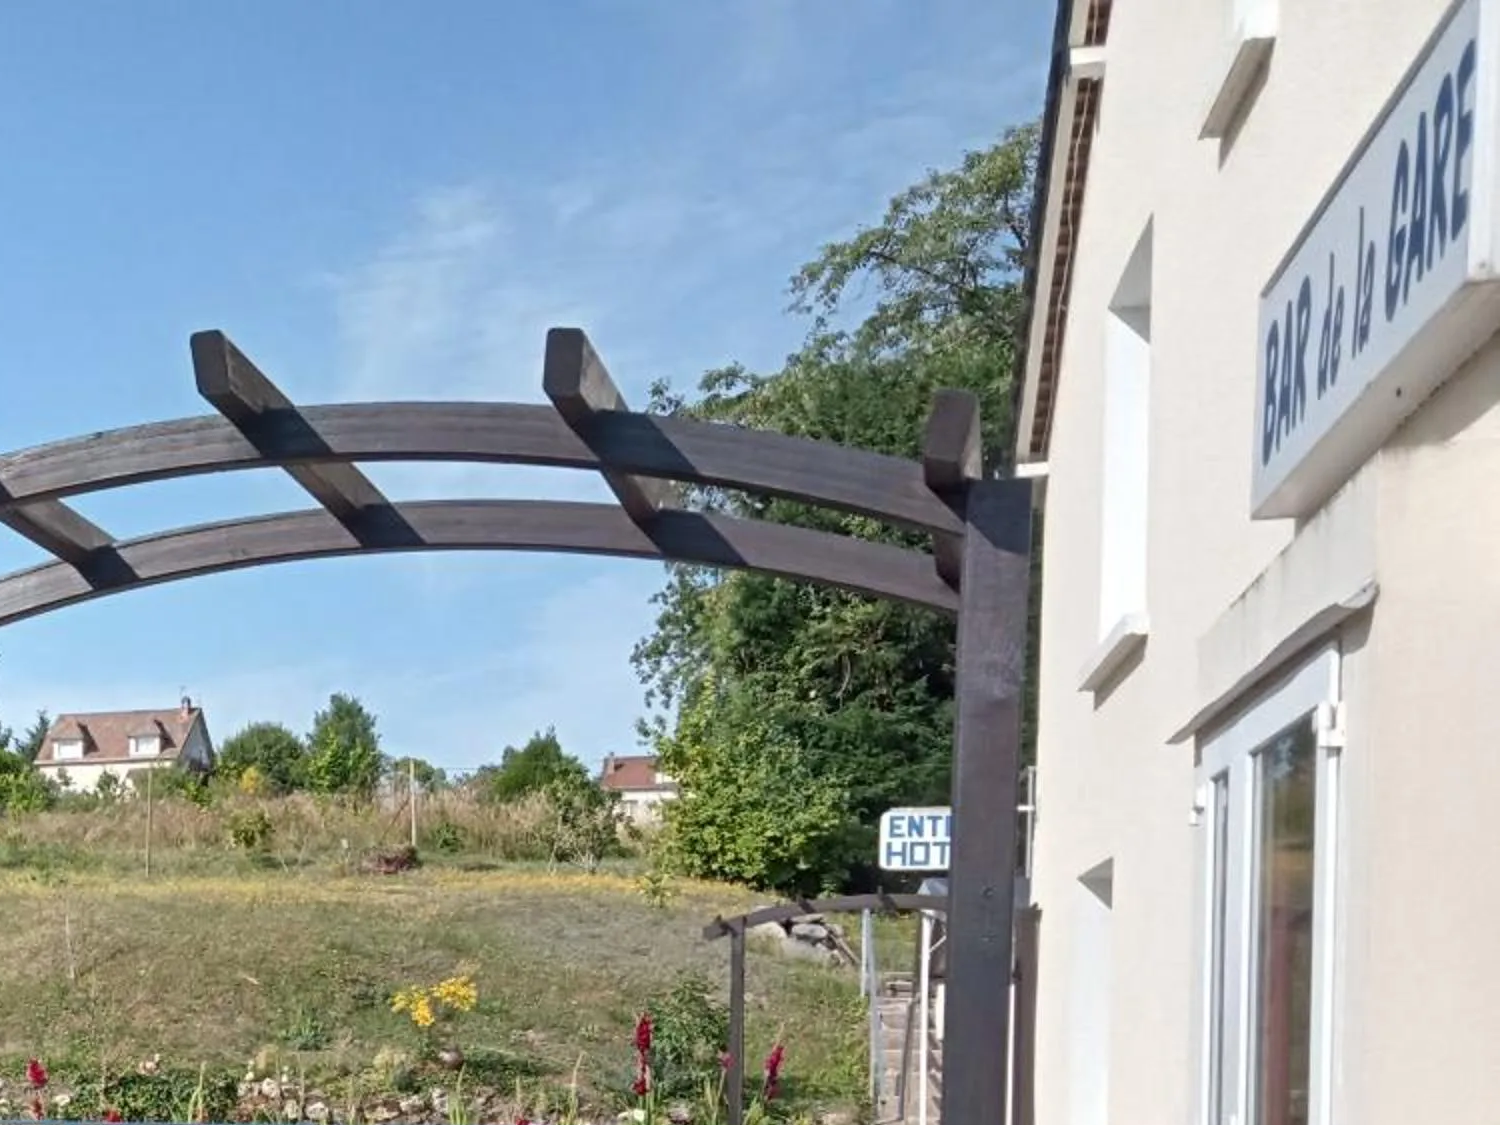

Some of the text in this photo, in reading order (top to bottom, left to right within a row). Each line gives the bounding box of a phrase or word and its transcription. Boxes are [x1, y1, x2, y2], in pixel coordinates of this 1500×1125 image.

[1262, 38, 1477, 468] BAR de la GARE
[886, 841, 951, 867] HOT
